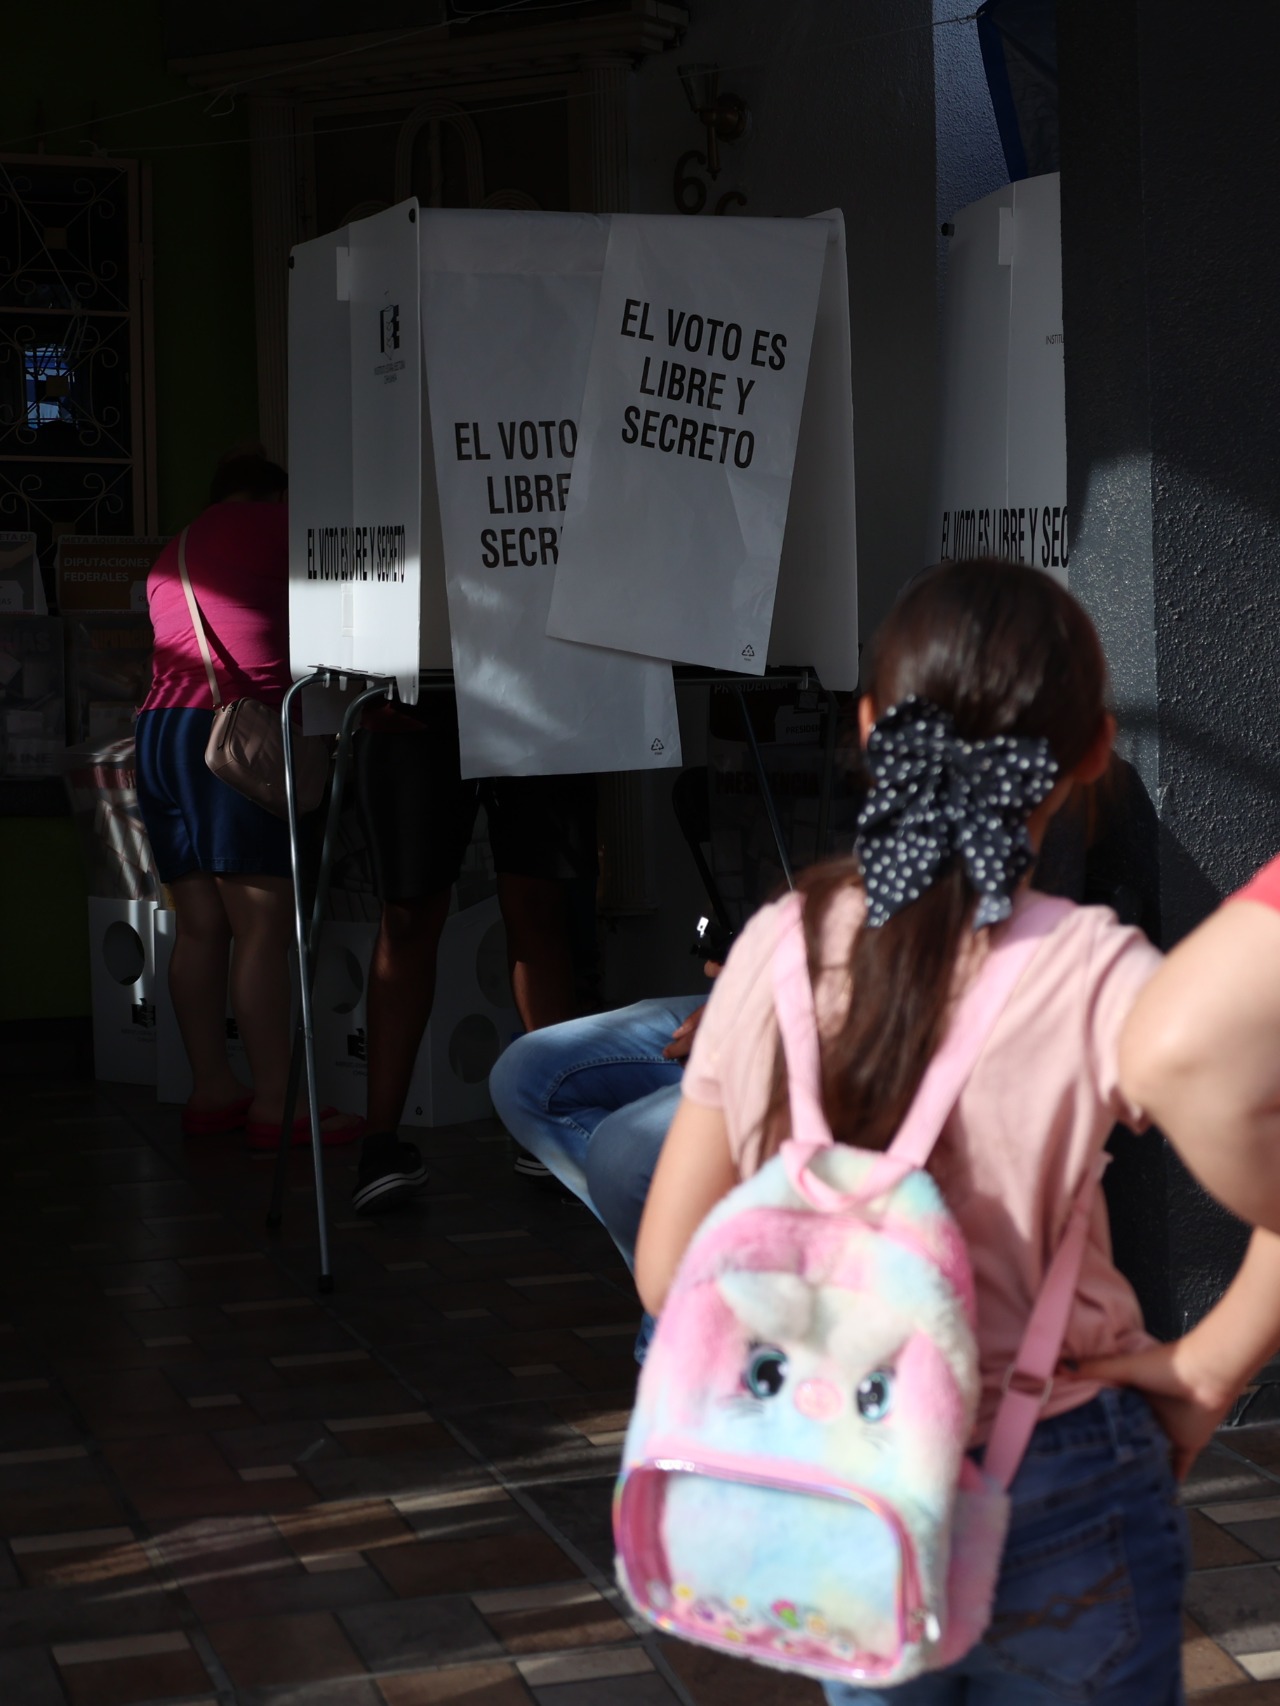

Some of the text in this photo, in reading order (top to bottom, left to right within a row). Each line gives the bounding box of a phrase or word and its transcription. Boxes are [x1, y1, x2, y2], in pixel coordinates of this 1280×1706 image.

[621, 298, 787, 371] EL VOTO ES
[640, 356, 756, 416] LIBRE Y
[454, 419, 578, 461] EL VOTO
[622, 405, 755, 469] SECRETO
[487, 473, 571, 514] LIBRE
[307, 528, 317, 580] EL
[319, 526, 339, 581] VOTO
[341, 526, 349, 581] ES
[369, 526, 376, 581] Y
[377, 525, 406, 583] SECRETO
[480, 527, 563, 569] SECR
[941, 511, 951, 564] EL
[953, 508, 976, 563] VOTO
[978, 508, 990, 562] ES
[1029, 507, 1038, 567] Y
[63, 557, 150, 568] DIPUTACIONES
[63, 572, 130, 582] FEDERALES
